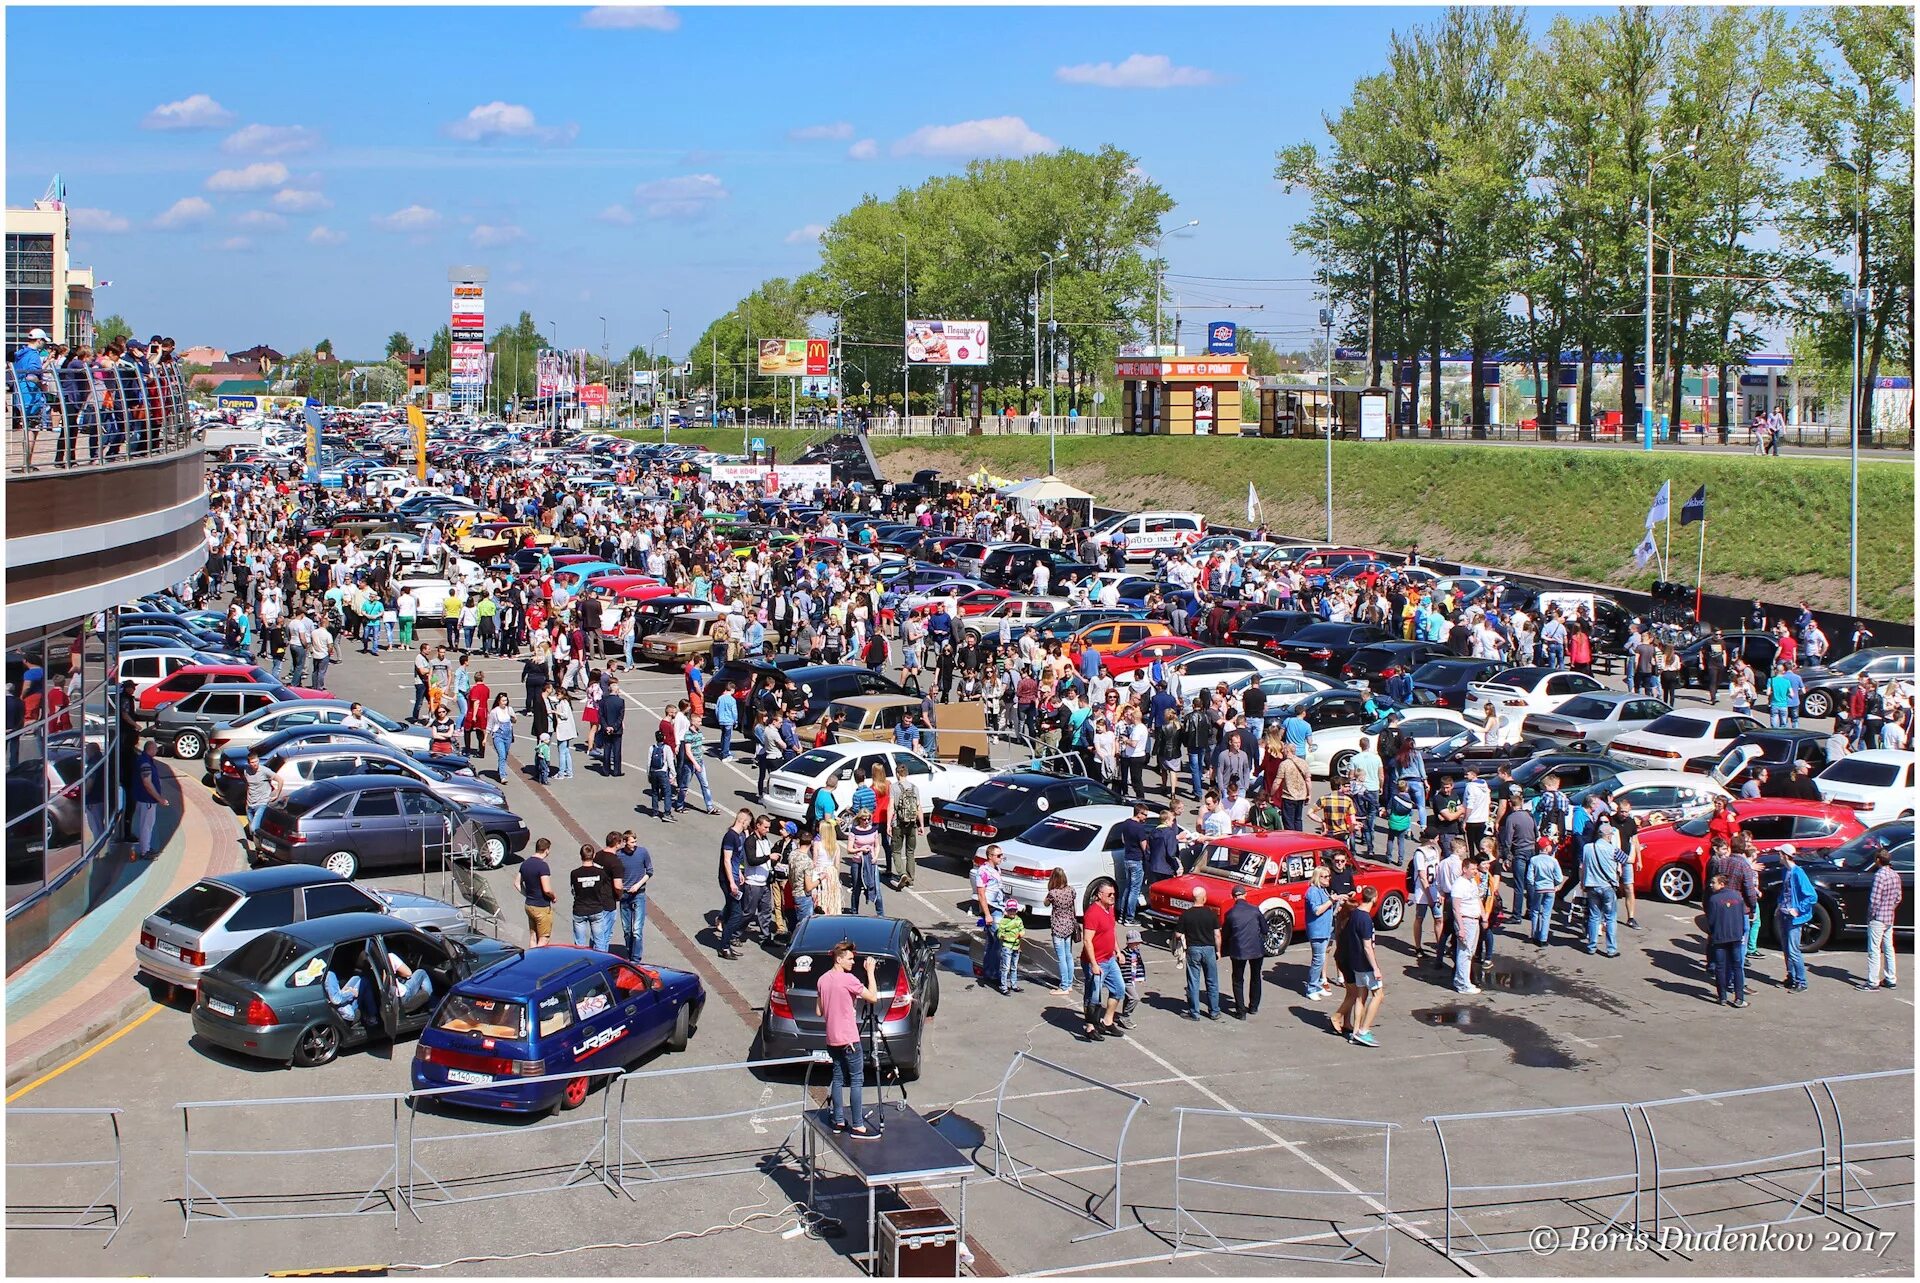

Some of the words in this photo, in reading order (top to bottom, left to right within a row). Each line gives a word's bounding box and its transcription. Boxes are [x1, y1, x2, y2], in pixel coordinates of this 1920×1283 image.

[1208, 364, 1232, 374] POINT
[228, 400, 254, 408] ЛЕНТА
[1244, 855, 1261, 873] 32
[1290, 862, 1301, 871] 32
[1303, 858, 1315, 870] 32
